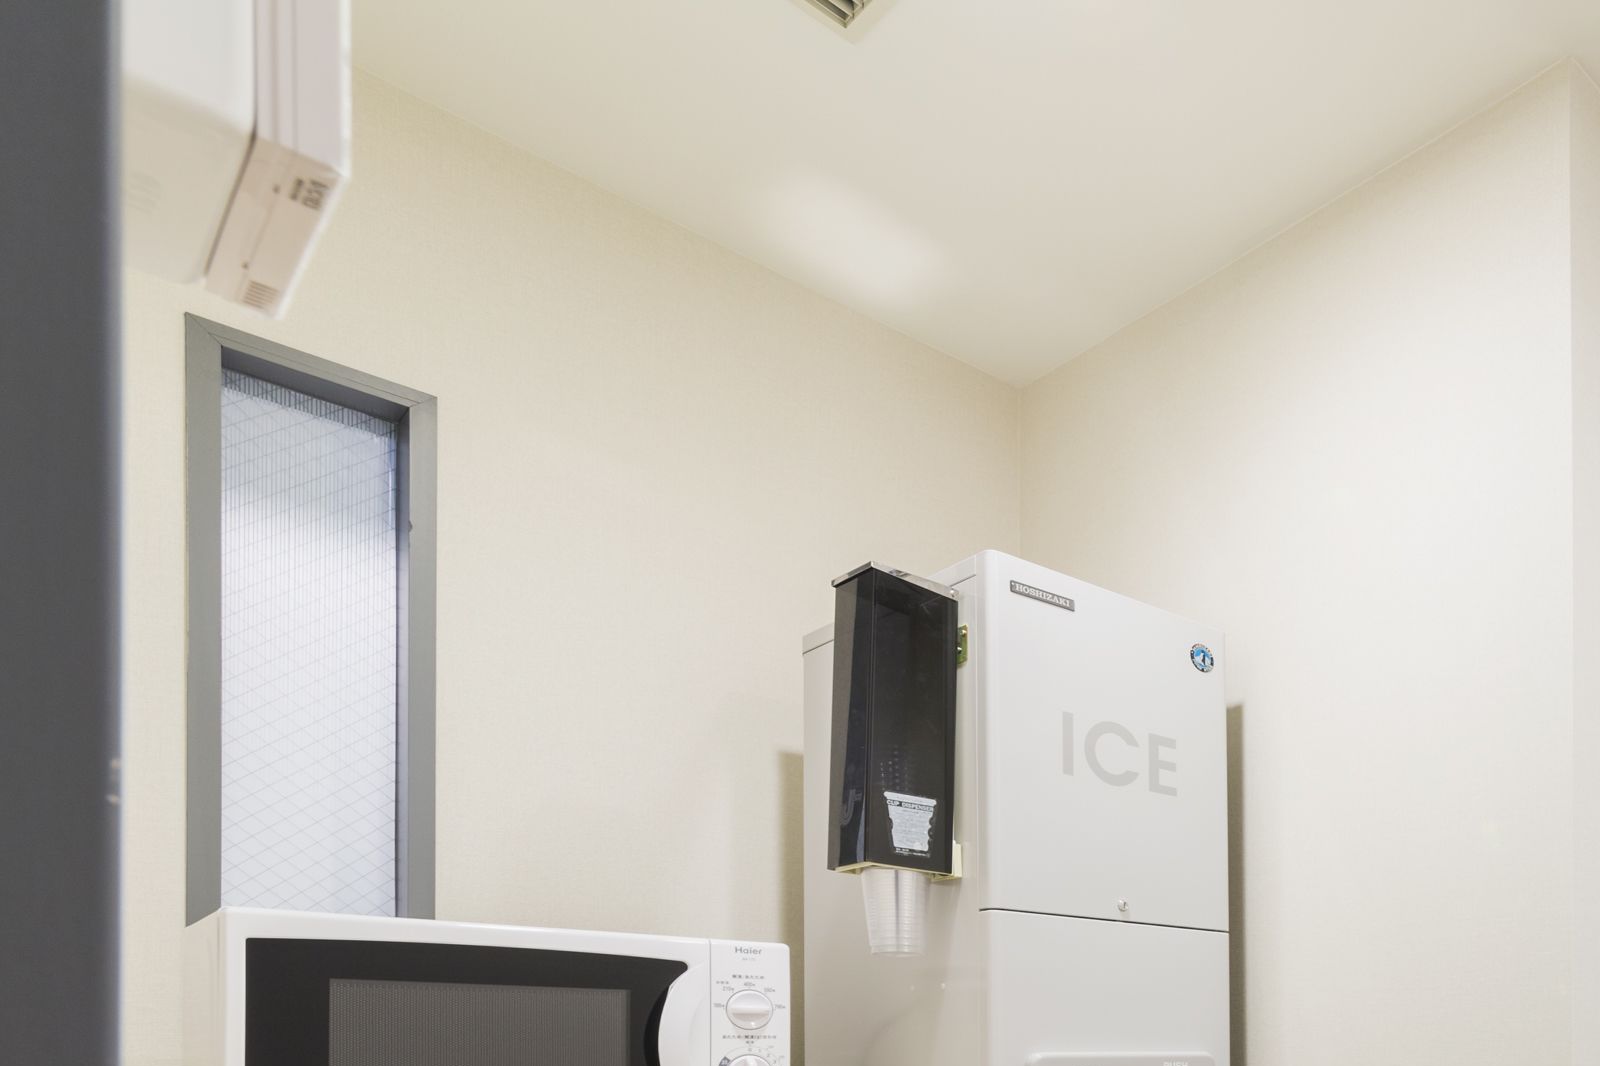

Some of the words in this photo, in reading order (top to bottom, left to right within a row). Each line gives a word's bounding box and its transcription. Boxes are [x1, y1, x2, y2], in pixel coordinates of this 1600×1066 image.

[1015, 583, 1071, 607] HOSHIZAKI
[1061, 711, 1178, 797] ICE
[735, 946, 762, 955] Haier
